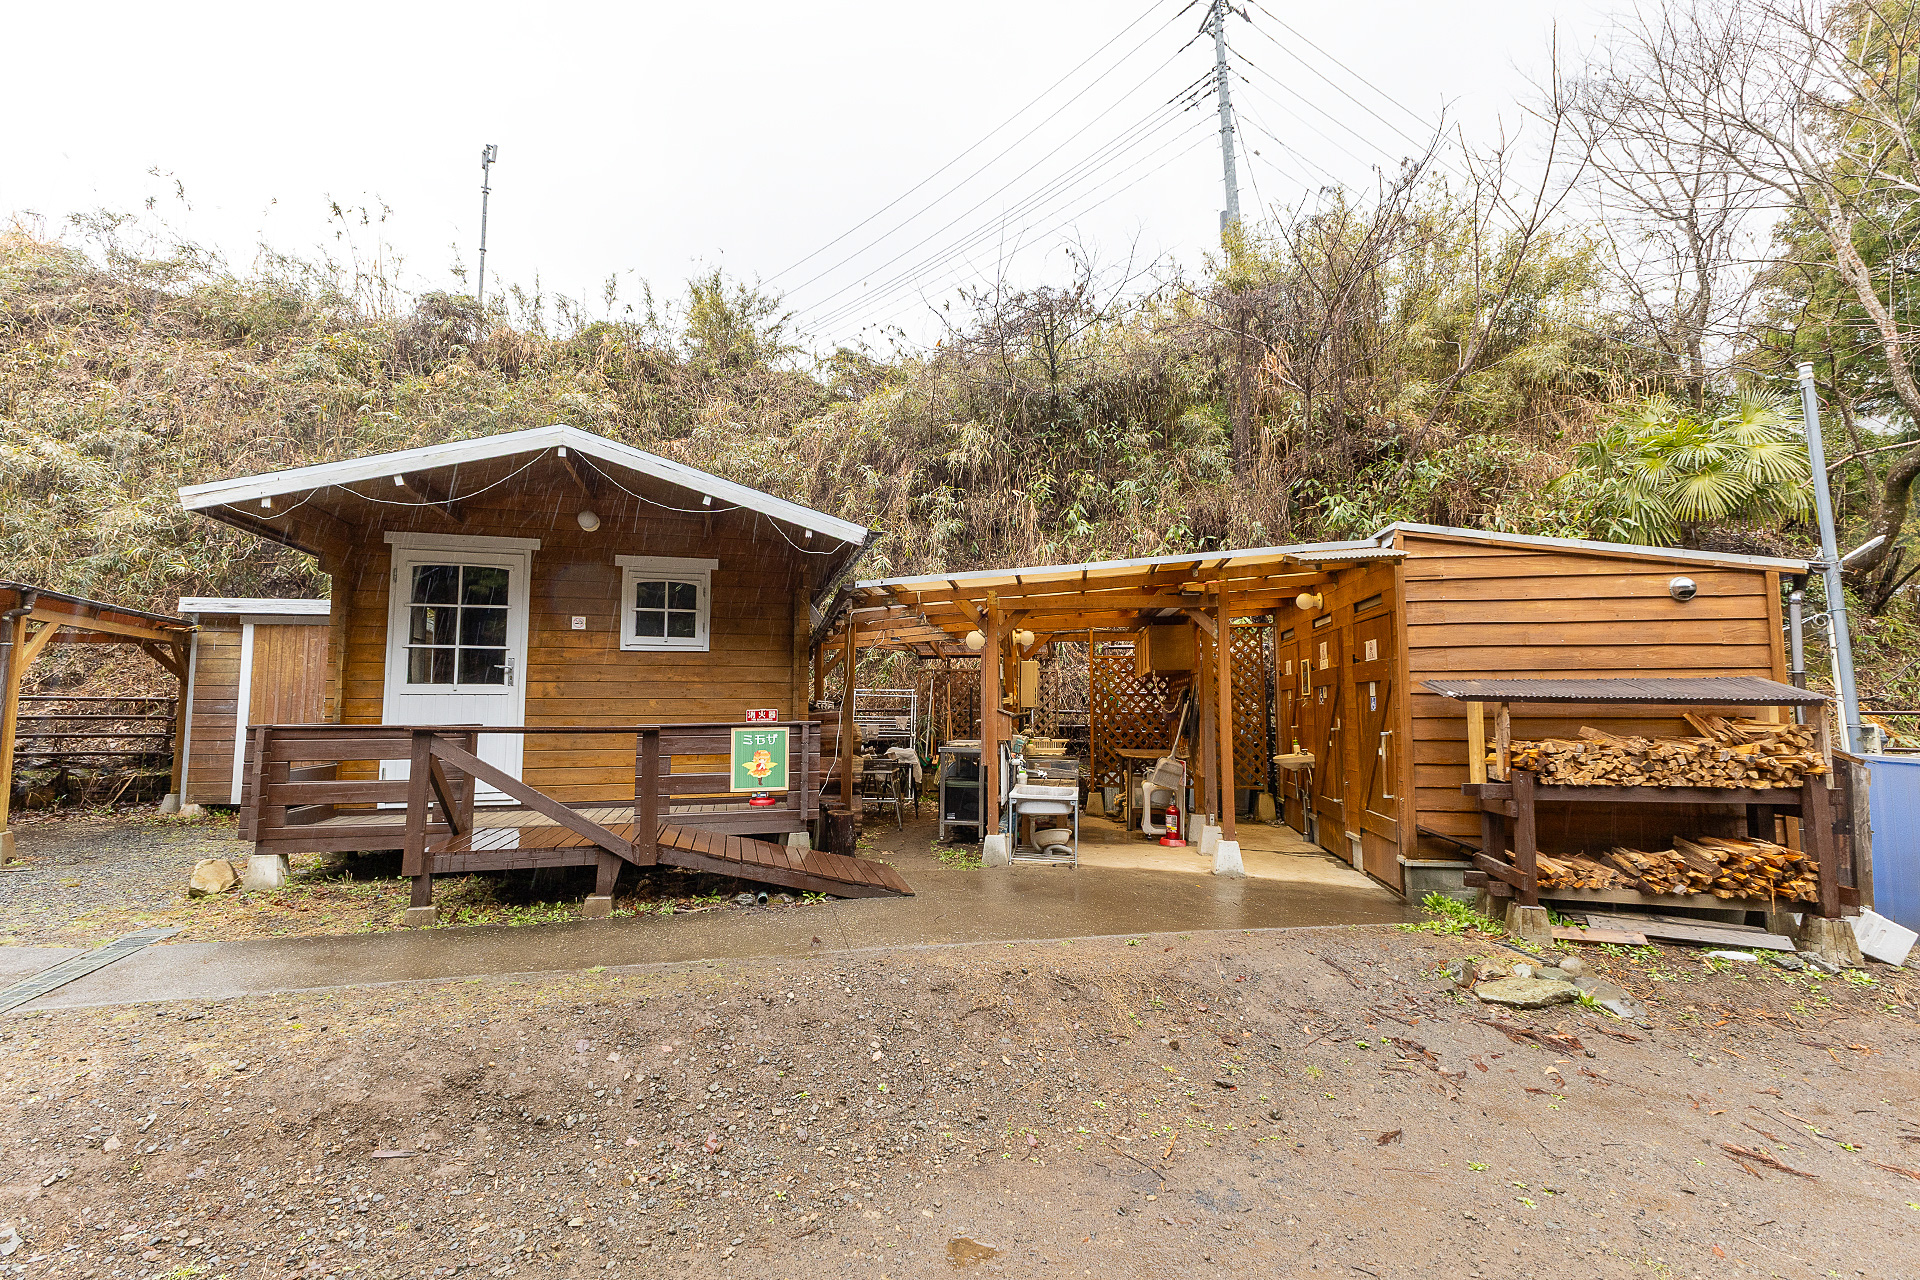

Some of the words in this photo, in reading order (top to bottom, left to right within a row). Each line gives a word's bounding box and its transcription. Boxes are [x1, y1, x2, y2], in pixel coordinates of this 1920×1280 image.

[747, 710, 776, 718] 消火器
[743, 733, 778, 745] ミモザ
